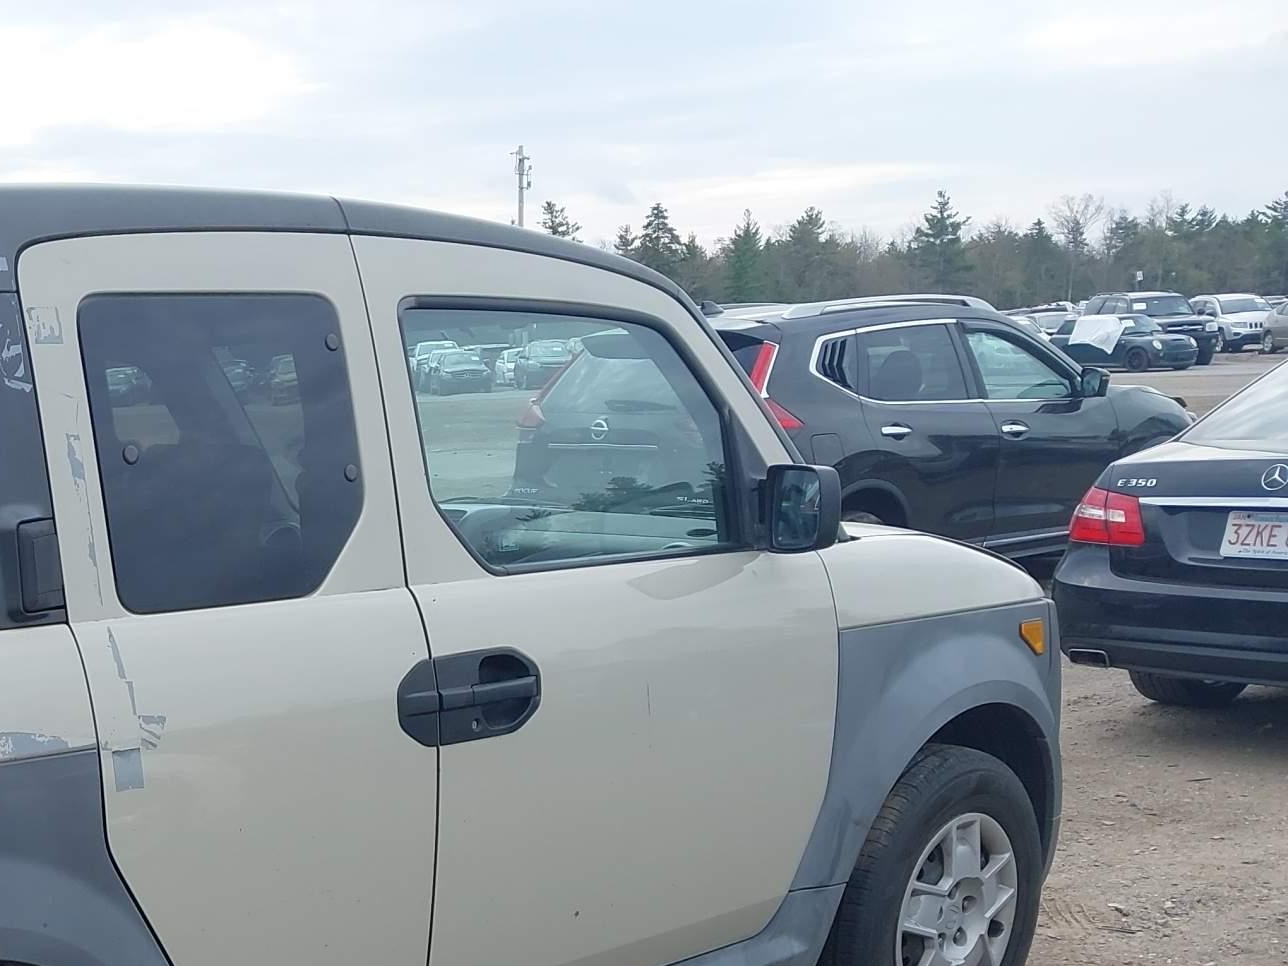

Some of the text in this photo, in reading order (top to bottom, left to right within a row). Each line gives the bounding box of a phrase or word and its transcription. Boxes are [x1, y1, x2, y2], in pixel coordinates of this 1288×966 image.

[1117, 478, 1158, 487] E 350
[1228, 523, 1283, 548] 3ZKE
